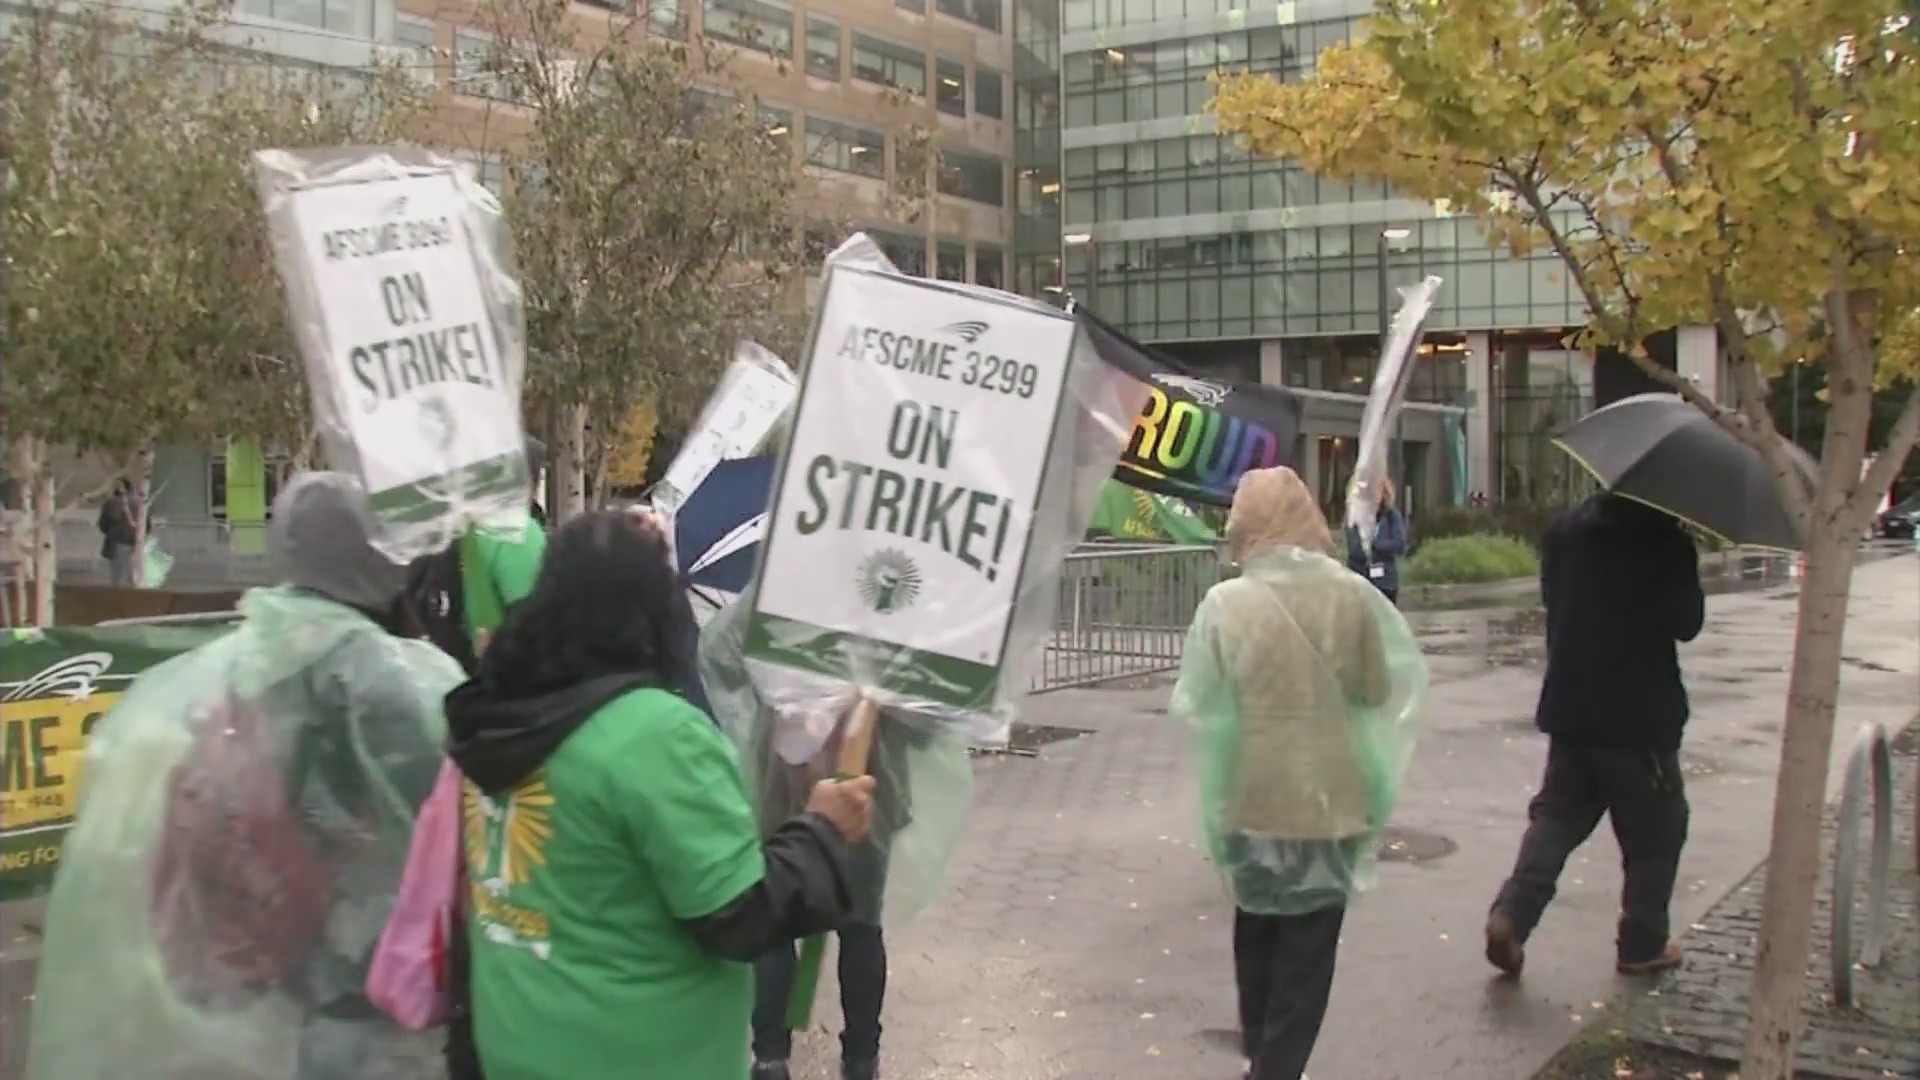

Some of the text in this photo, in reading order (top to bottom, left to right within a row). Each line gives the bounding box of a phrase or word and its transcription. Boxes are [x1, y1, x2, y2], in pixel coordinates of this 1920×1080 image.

[381, 271, 432, 326] ON
[350, 321, 493, 414] STRIKE!
[838, 325, 1038, 399] AFSCME 3299
[887, 399, 959, 469] ON
[796, 454, 1013, 583] STRIKE!
